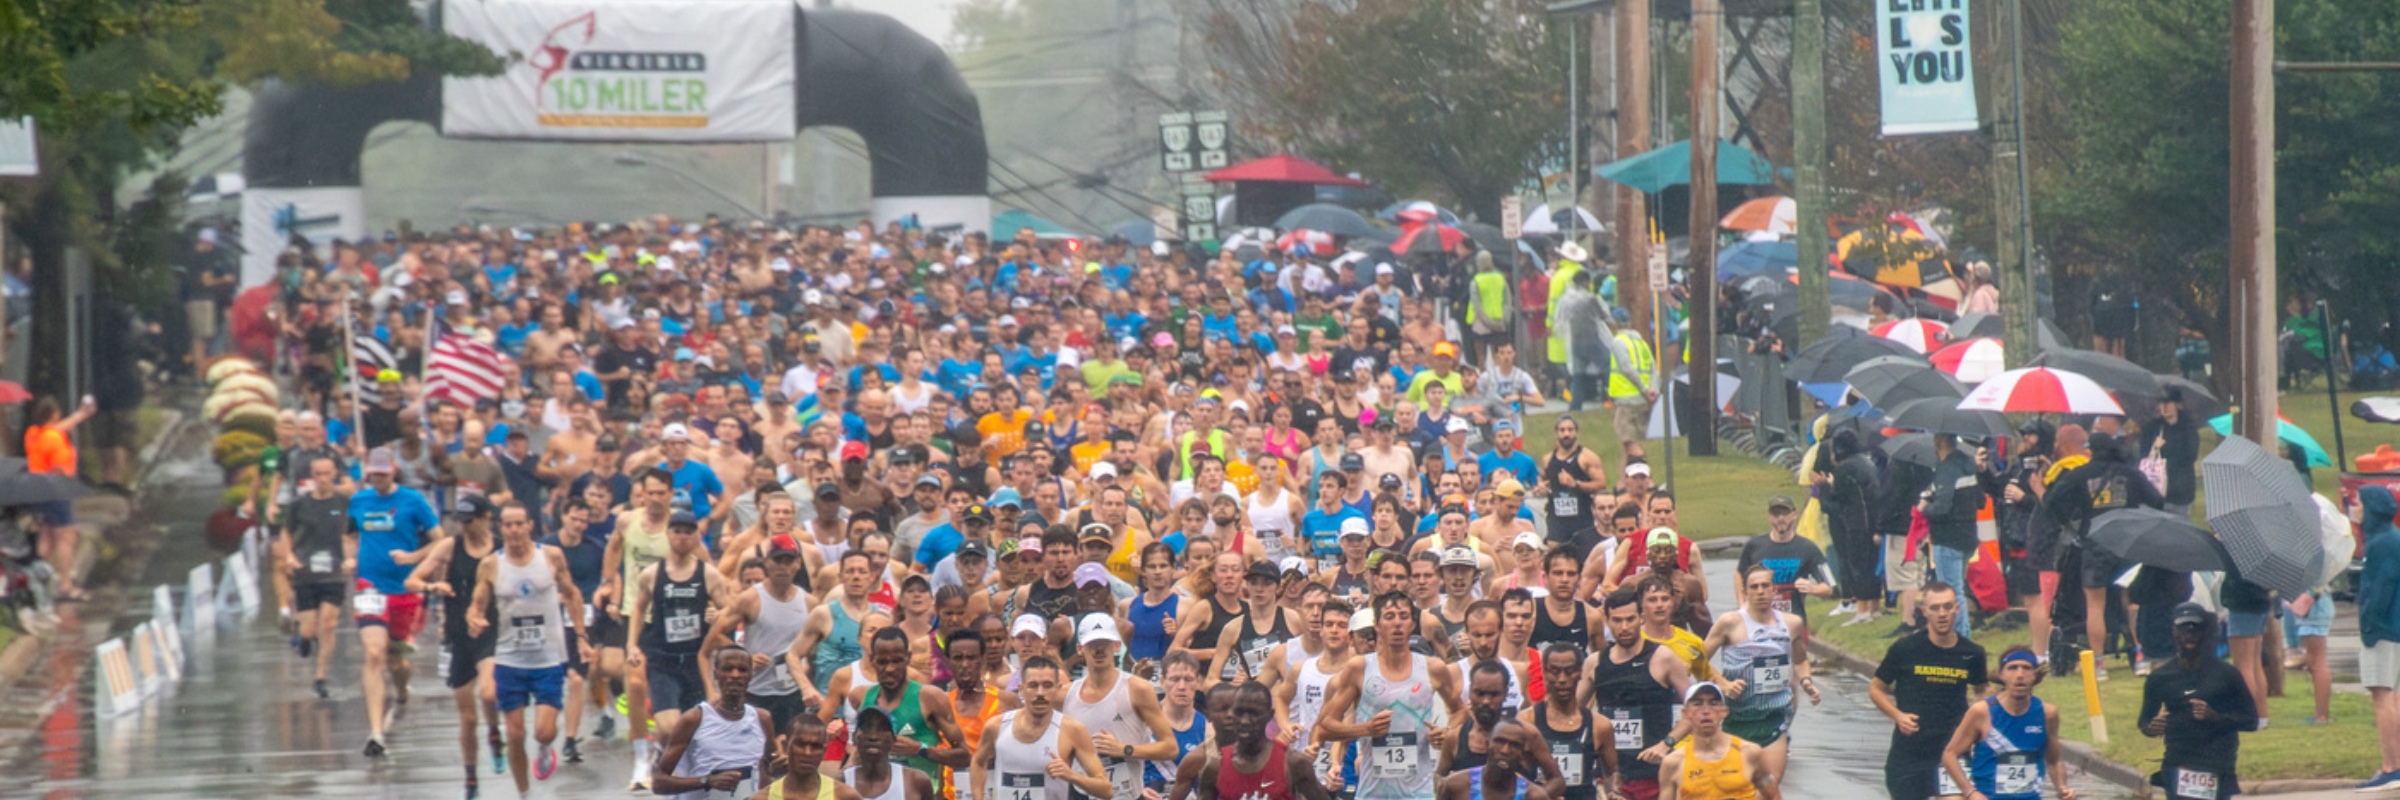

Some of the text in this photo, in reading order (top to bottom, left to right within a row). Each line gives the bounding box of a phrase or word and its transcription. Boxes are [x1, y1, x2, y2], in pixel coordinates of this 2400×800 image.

[578, 53, 701, 70] VIRGINIA
[1890, 51, 1964, 84] YOU
[553, 78, 708, 112] 10 MILER
[1764, 669, 1781, 682] 26
[1385, 748, 1405, 763] 13
[2007, 767, 2026, 780] 24
[2180, 772, 2216, 789] 4105
[1012, 789, 1033, 800] 14
